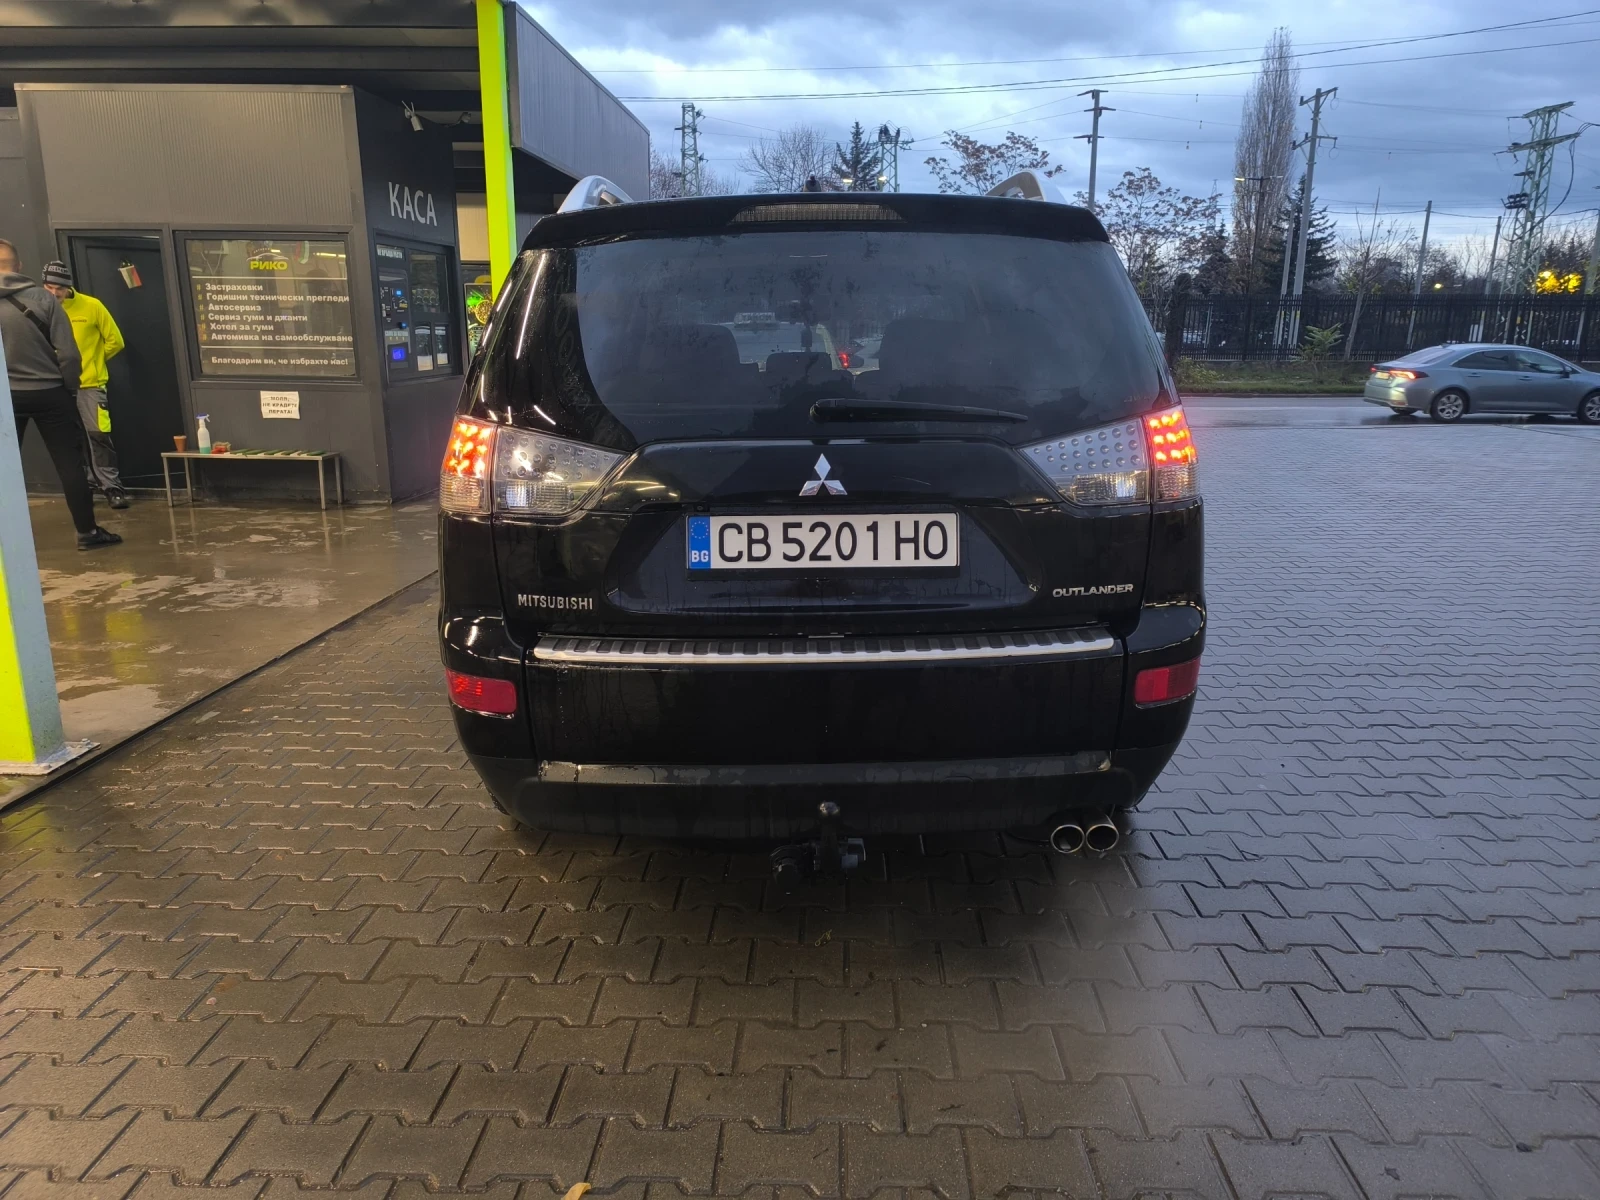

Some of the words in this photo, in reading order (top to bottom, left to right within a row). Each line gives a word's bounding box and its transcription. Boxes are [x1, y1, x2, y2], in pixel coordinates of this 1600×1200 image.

[388, 181, 438, 227] КАСА
[250, 260, 288, 270] РИКО
[205, 282, 263, 292] Застраховки
[206, 292, 248, 302] Годишни
[249, 294, 304, 302] технически
[306, 295, 350, 303] прегледи
[208, 303, 262, 313] Автосервиз
[208, 312, 241, 322] Сервиз
[242, 314, 265, 323] гуми
[274, 314, 308, 322] джанти
[209, 322, 237, 330] Хотел
[252, 324, 275, 333] гуми
[211, 332, 260, 341] Автомивка
[274, 333, 353, 343] самообслужване
[211, 356, 262, 366] Благодарим
[263, 358, 277, 366] ви,
[290, 357, 329, 367] избрахте
[718, 522, 772, 562] CB
[782, 520, 880, 562] 5201
[894, 520, 948, 561] HO
[691, 550, 709, 563] BG
[1052, 583, 1134, 598] OUTLANDER
[517, 593, 593, 610] MITSUBISHI
